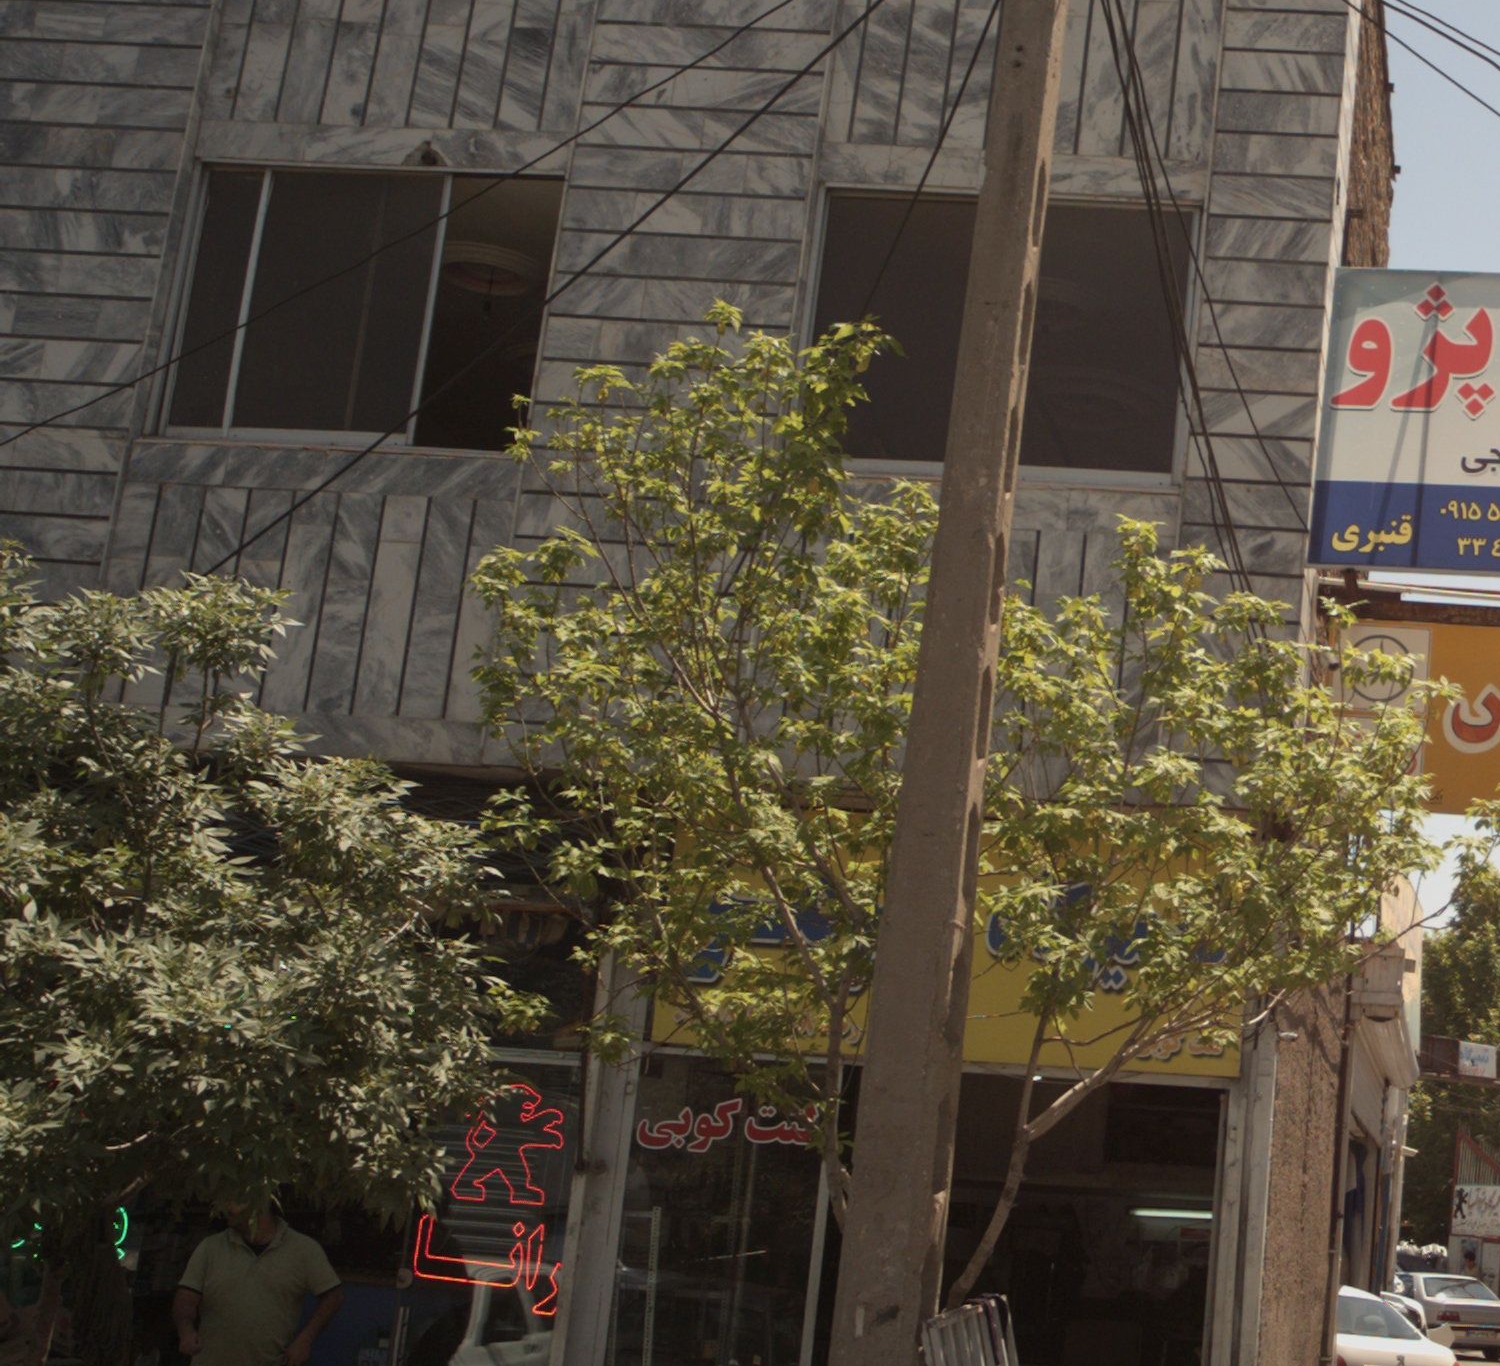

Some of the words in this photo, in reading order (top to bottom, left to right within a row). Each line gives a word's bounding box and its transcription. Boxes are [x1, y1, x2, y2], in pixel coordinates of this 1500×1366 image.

[1331, 284, 1496, 418] پژو
[1330, 513, 1414, 554] قنبری
[638, 1099, 743, 1152] کوبی
